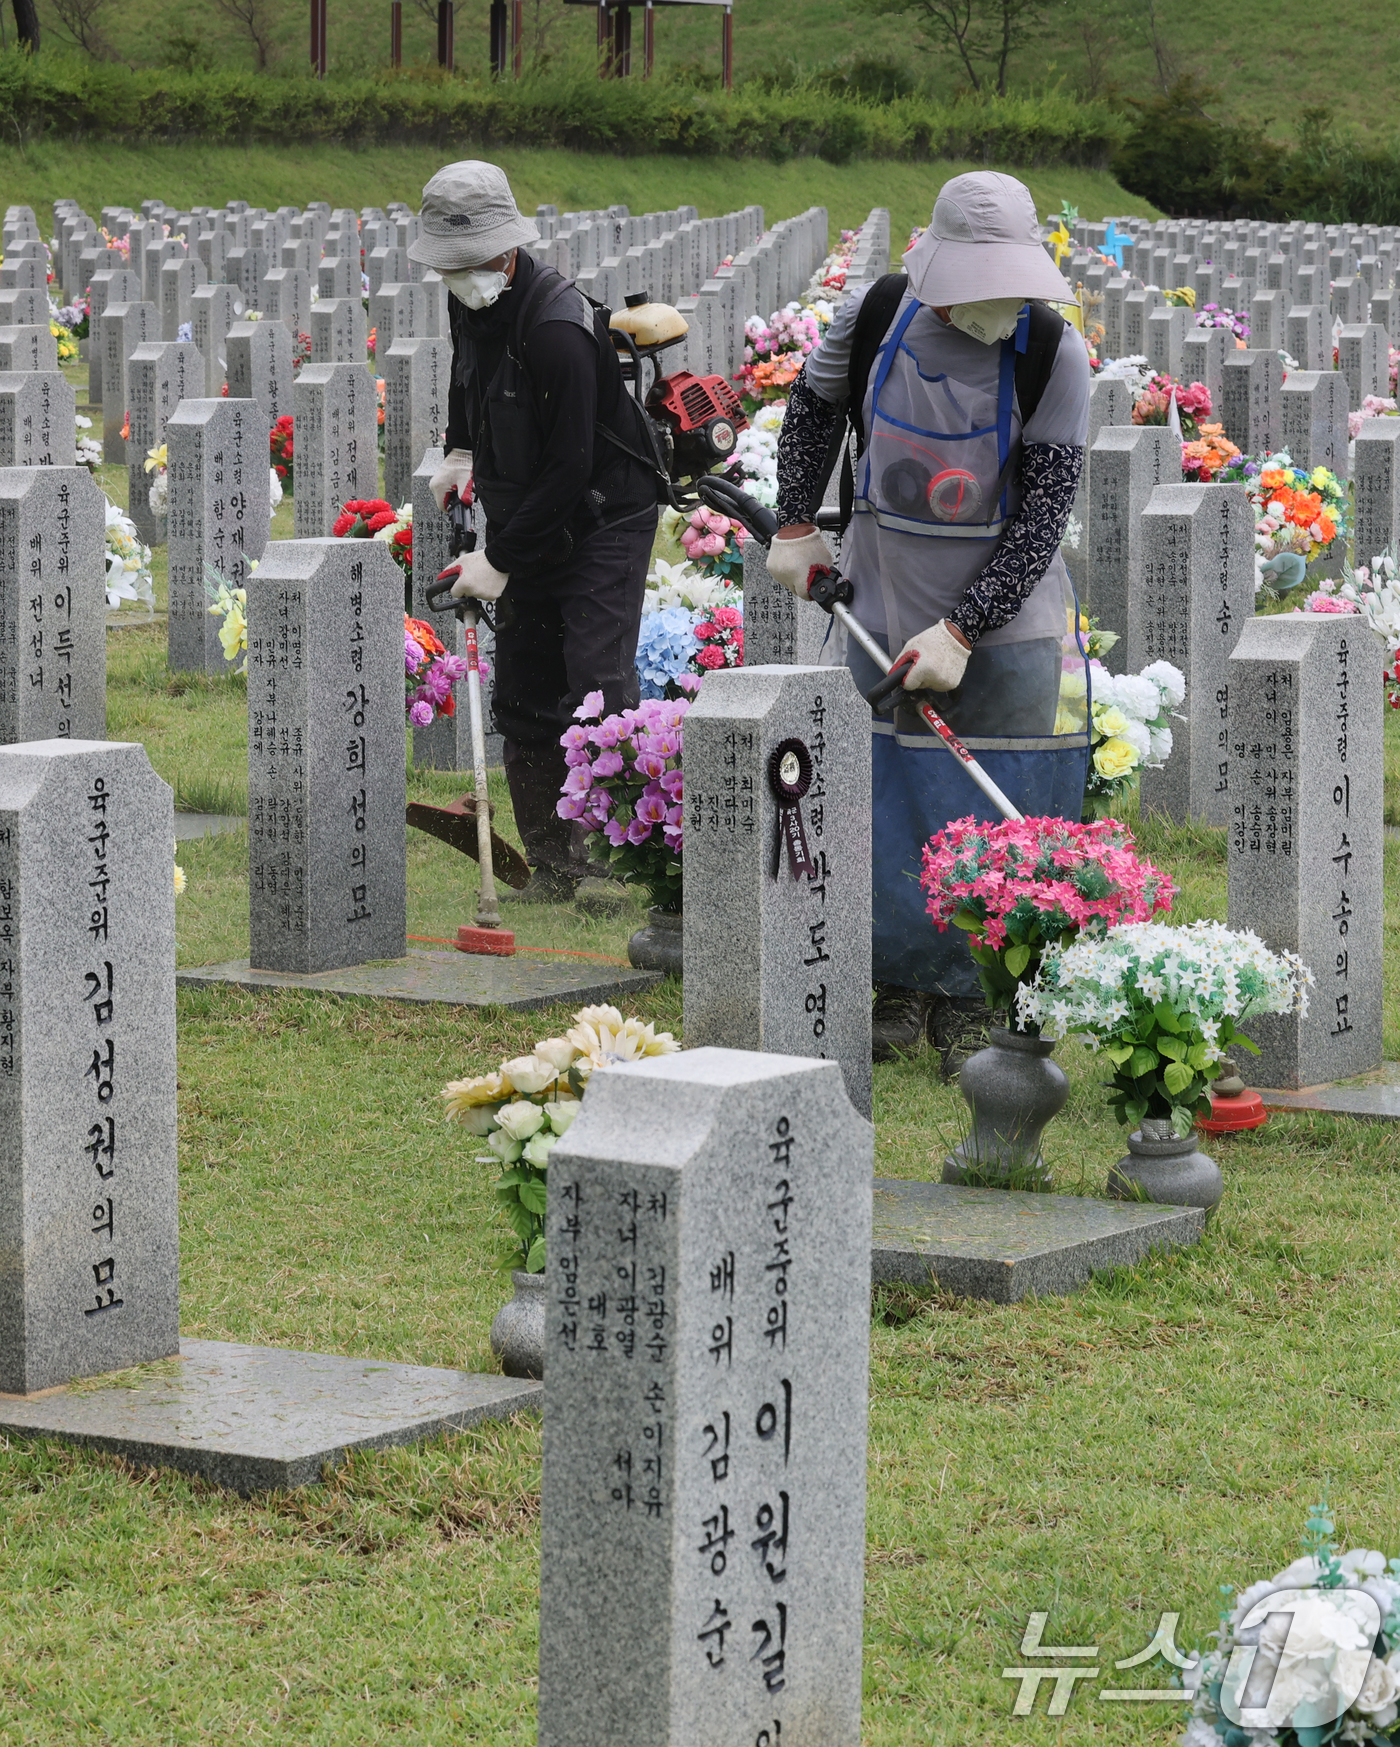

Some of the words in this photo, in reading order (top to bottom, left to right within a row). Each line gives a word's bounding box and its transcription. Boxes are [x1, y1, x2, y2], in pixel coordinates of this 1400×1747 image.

[23, 414, 32, 446] 배위
[41, 382, 51, 447] 육군소령
[214, 451, 225, 485] 배위
[232, 412, 244, 485] 육군소령
[57, 484, 70, 576] 육군준위
[213, 500, 226, 575] 함순자
[1168, 524, 1178, 547] 자녀
[1219, 500, 1230, 591] 육군중령
[30, 533, 42, 580] 배위
[417, 550, 425, 572] 사위
[278, 591, 289, 618] 자녀
[291, 591, 301, 602] 처
[349, 560, 365, 674] 해병소령
[1146, 596, 1155, 607] 손
[1157, 595, 1166, 617] 사위
[29, 595, 43, 692] 전성녀
[253, 638, 264, 668] 미자
[266, 639, 277, 669] 민규
[278, 625, 289, 670] 강미선
[291, 625, 303, 670] 이명숙
[749, 632, 758, 645] 손
[772, 632, 782, 656] 사위
[785, 632, 795, 656] 자부
[266, 678, 277, 707] 자부
[1265, 672, 1278, 704] 자녀
[1281, 673, 1292, 690] 처
[1335, 638, 1349, 764] 육군중령
[266, 711, 277, 757] 나혜승
[279, 727, 290, 756] 선규
[292, 727, 303, 756] 종규
[724, 732, 738, 769] 자녀
[740, 732, 753, 751] 처
[1234, 742, 1246, 759] 영
[1250, 743, 1263, 760] 광
[1281, 709, 1294, 760] 임용은
[266, 765, 277, 780] 손
[293, 765, 303, 791] 사위
[809, 695, 827, 838] 육군소령
[1250, 769, 1263, 785] 손
[1265, 769, 1278, 800] 사위
[1281, 769, 1294, 800] 자부
[707, 794, 719, 833] 진진
[740, 776, 755, 834] 최미숙
[1234, 804, 1247, 854] 이강인
[1249, 805, 1262, 853] 송승리
[1265, 805, 1278, 854] 송장혁
[1281, 806, 1293, 856] 임미림
[87, 777, 111, 945] 육군준위
[346, 884, 372, 924] 묘
[1330, 993, 1353, 1037] 묘
[560, 1181, 584, 1243] 자부
[617, 1188, 642, 1252] 자녀
[647, 1191, 667, 1223] 처
[763, 1116, 795, 1350] 육군중위
[83, 1257, 125, 1317] 묘
[558, 1254, 581, 1352] 임은선
[708, 1251, 734, 1368] 배위
[587, 1291, 609, 1352] 대호
[616, 1261, 640, 1359] 이광열
[645, 1265, 669, 1363] 김광순
[643, 1382, 665, 1414] 손
[611, 1450, 636, 1513] 서아
[643, 1422, 664, 1518] 이지유
[697, 1411, 735, 1669] 김광순
[749, 1378, 792, 1695] 이원길
